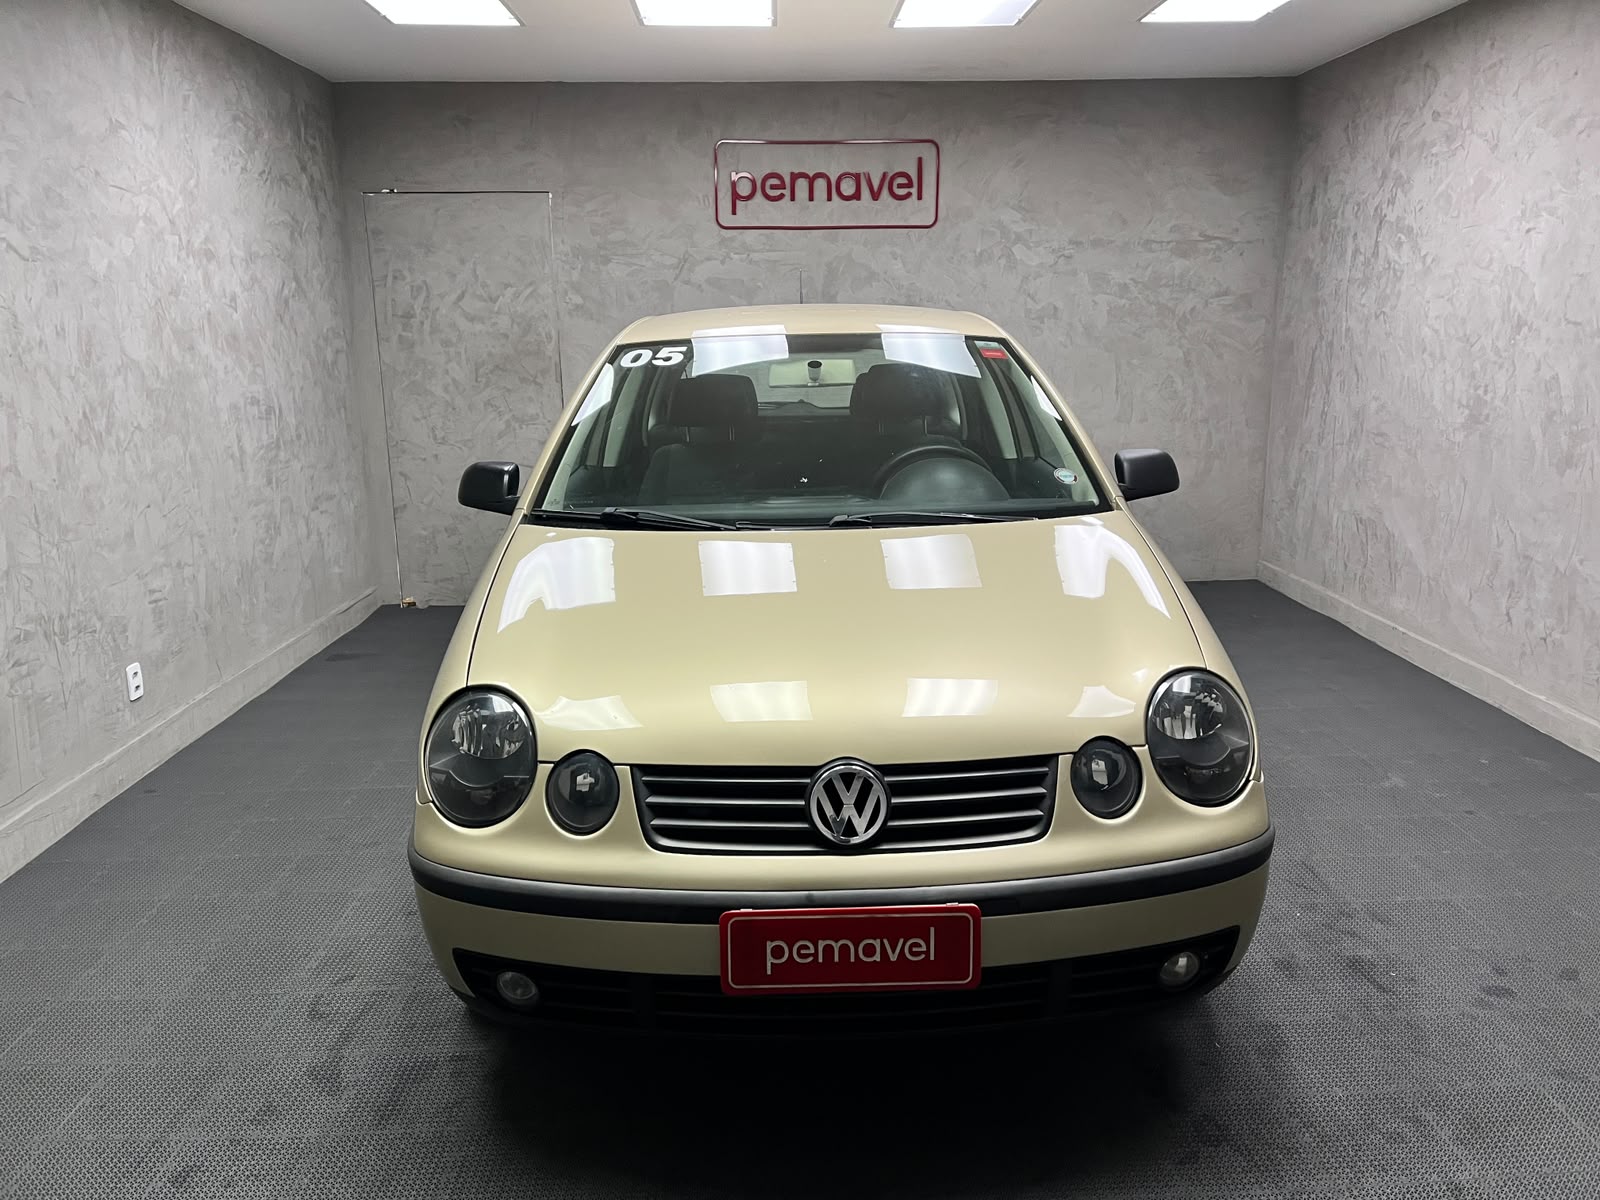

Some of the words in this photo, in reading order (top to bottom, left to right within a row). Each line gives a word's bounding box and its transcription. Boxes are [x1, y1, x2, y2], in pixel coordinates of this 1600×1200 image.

[730, 156, 923, 215] pemavel
[620, 346, 688, 368] 05
[812, 767, 885, 841] VW
[766, 926, 935, 975] pemavel
